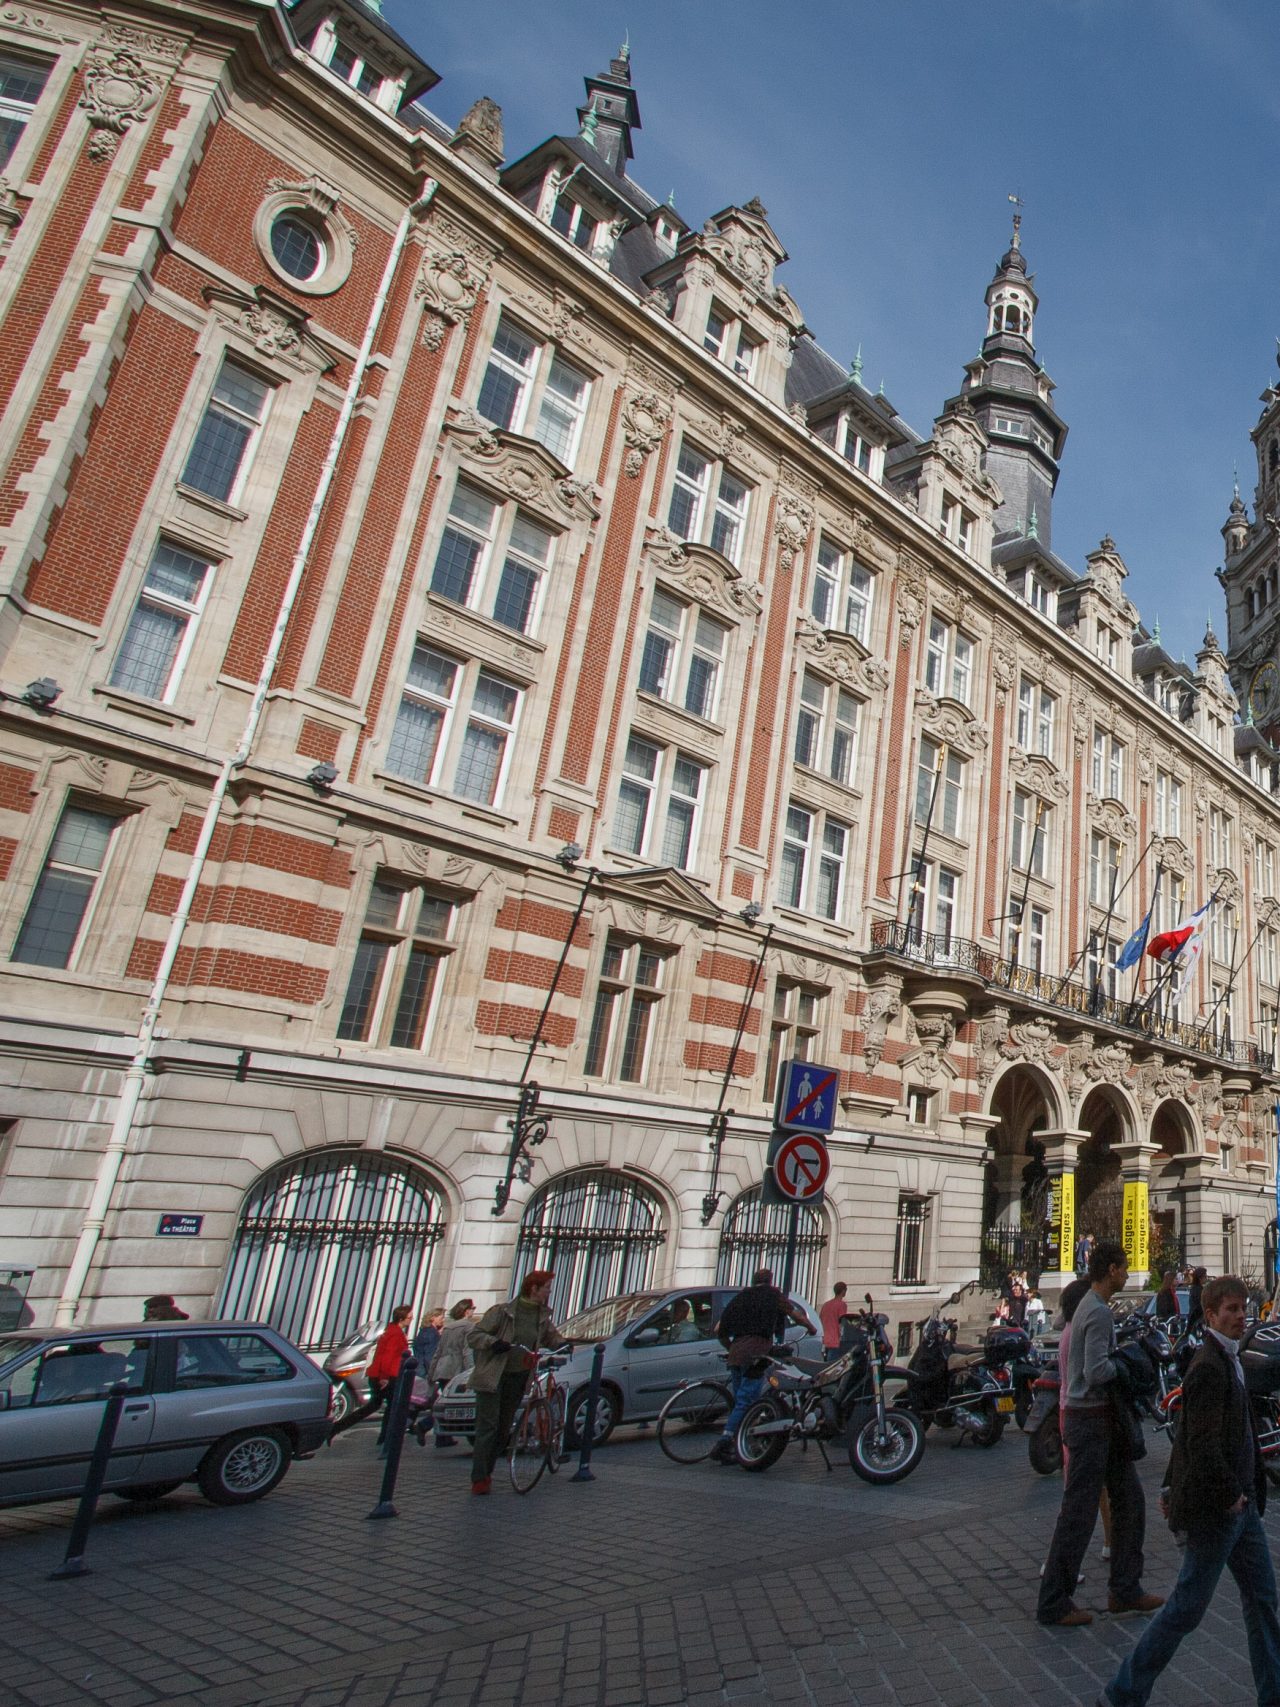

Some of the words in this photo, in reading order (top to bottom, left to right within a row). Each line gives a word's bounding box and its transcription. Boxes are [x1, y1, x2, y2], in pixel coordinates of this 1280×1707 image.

[1045, 1191, 1053, 1222] Jacques
[1050, 1177, 1062, 1227] VILLEGLÉ
[1063, 1213, 1071, 1253] vosges
[1125, 1218, 1134, 1255] vosges
